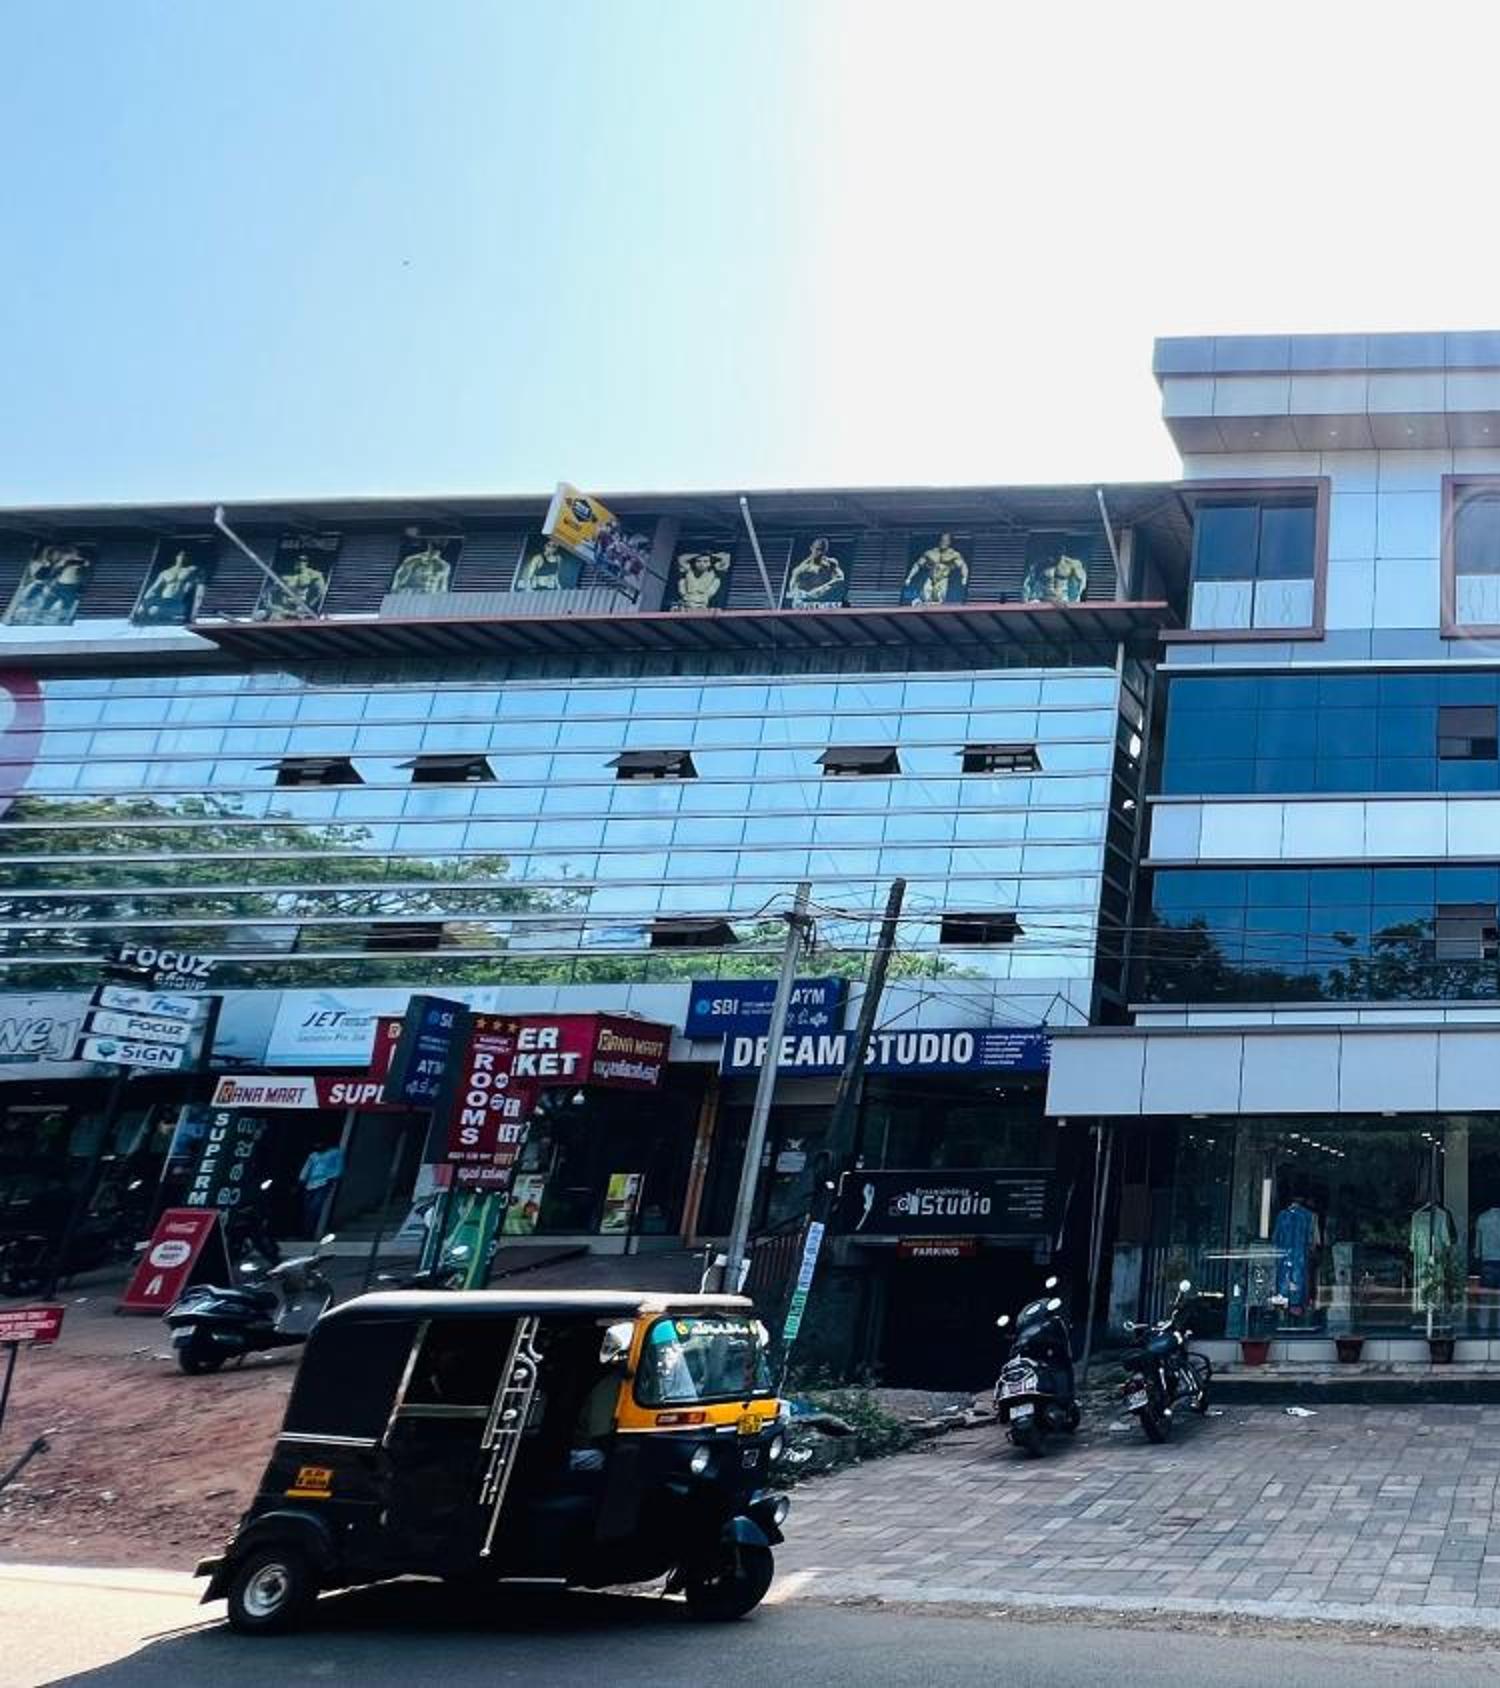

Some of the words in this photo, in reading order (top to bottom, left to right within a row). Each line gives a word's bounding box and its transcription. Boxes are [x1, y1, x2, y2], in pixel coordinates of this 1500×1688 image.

[119, 942, 212, 977] FOCUZ
[790, 988, 825, 1005] ATM
[712, 999, 738, 1015] SBI
[301, 1011, 346, 1027] JET
[262, 1086, 307, 1103] MART
[459, 1053, 495, 1145] ROOMS
[187, 1113, 230, 1206] SUPERM
[912, 1247, 960, 1257] PARKING
